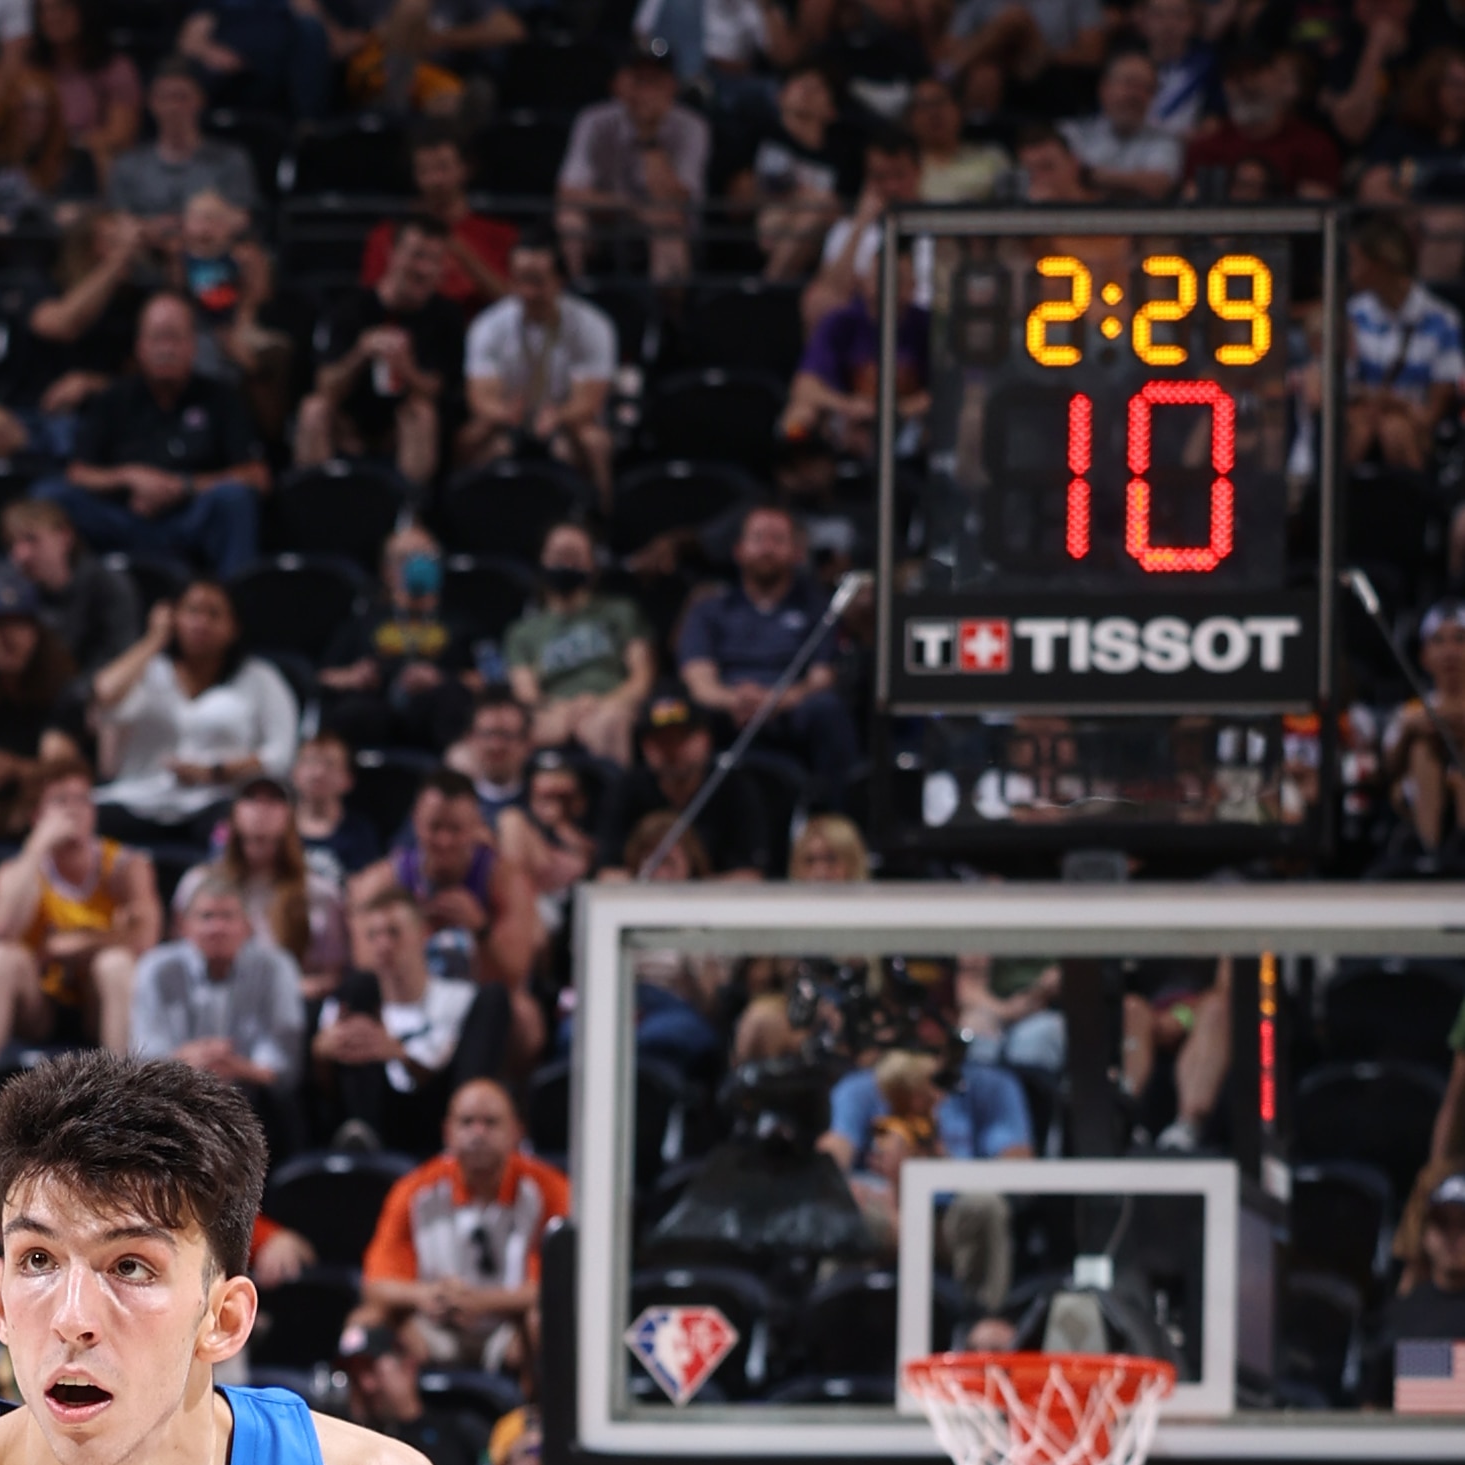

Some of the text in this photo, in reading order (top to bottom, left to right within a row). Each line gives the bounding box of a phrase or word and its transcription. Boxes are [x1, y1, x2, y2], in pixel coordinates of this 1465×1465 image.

[1026, 255, 1273, 367] 2:29
[1066, 380, 1235, 573] 10
[1014, 616, 1301, 673] TISSOT
